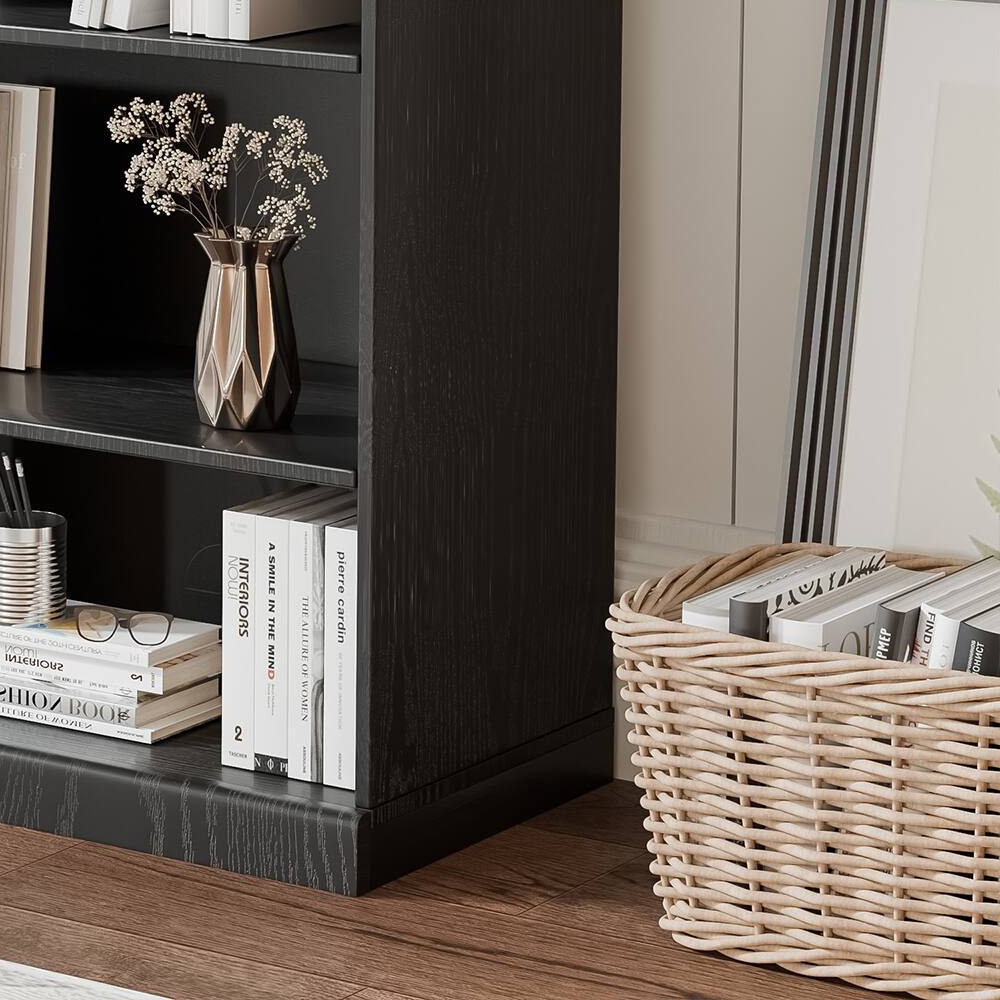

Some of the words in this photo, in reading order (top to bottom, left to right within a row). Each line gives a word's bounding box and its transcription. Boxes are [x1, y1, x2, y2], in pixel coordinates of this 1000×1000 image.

[268, 542, 276, 552] A
[227, 555, 239, 600] NOW!
[267, 555, 276, 596] SMILE
[336, 551, 345, 594] pierre
[238, 557, 249, 638] INTERIORS
[268, 599, 276, 613] IN
[302, 596, 310, 618] THE
[268, 616, 276, 642] THE
[337, 598, 345, 644] cardin
[923, 611, 936, 645] FIND
[301, 619, 309, 661] ALLURE
[876, 627, 892, 661] РМЕР
[267, 644, 275, 681] MIND
[301, 663, 309, 678] OF
[971, 641, 985, 676] ОНИСТ
[301, 680, 309, 722] WOMEN
[234, 725, 243, 742] 2
